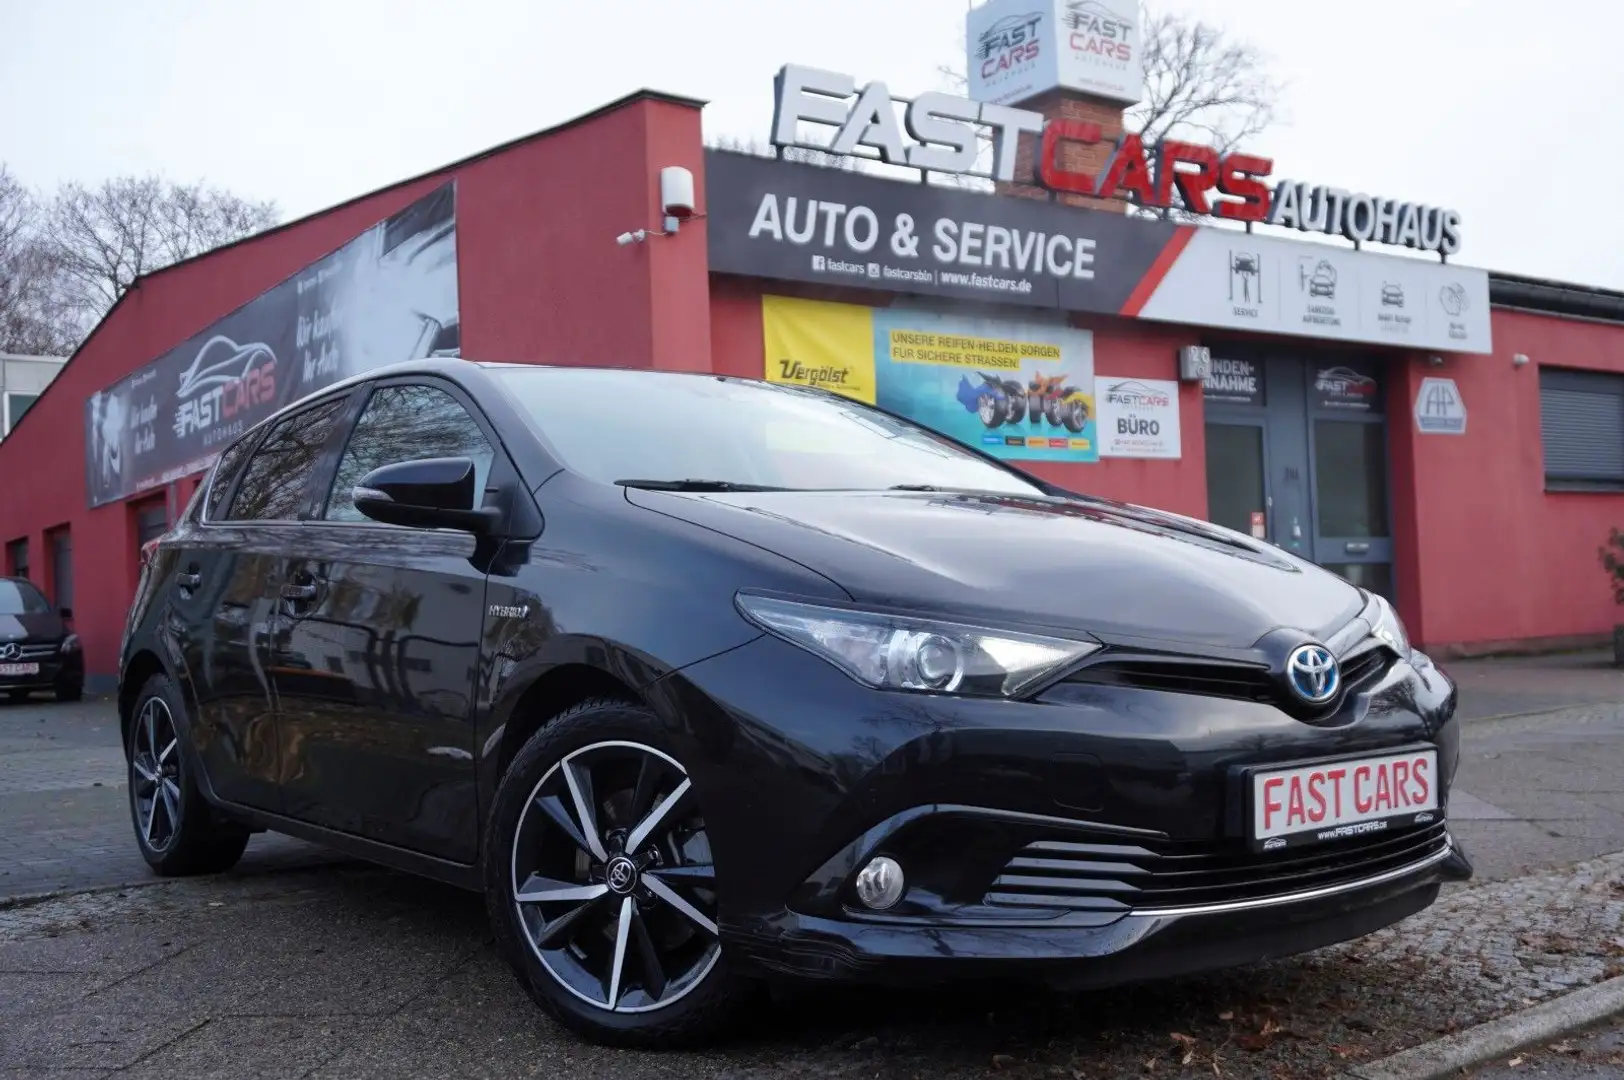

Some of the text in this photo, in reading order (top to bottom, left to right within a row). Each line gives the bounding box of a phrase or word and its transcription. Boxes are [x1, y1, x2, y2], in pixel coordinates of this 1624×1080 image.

[980, 16, 1042, 59] FAST
[1067, 11, 1132, 41] FAST
[981, 39, 1040, 79] CARS
[1069, 33, 1131, 62] CARS
[1269, 178, 1461, 256] AUTOHAUS
[749, 193, 1097, 279] AUTO & SERVICE
[827, 259, 865, 274] fastcars
[941, 269, 1033, 293] www.fastcars.de
[892, 332, 935, 346] UNSERE
[1020, 343, 1060, 359] SORGEN
[916, 348, 962, 363] SICHERE
[779, 359, 849, 386] Vergölst
[1117, 413, 1160, 436] BÜRO
[1263, 758, 1429, 830] FAST CARS
